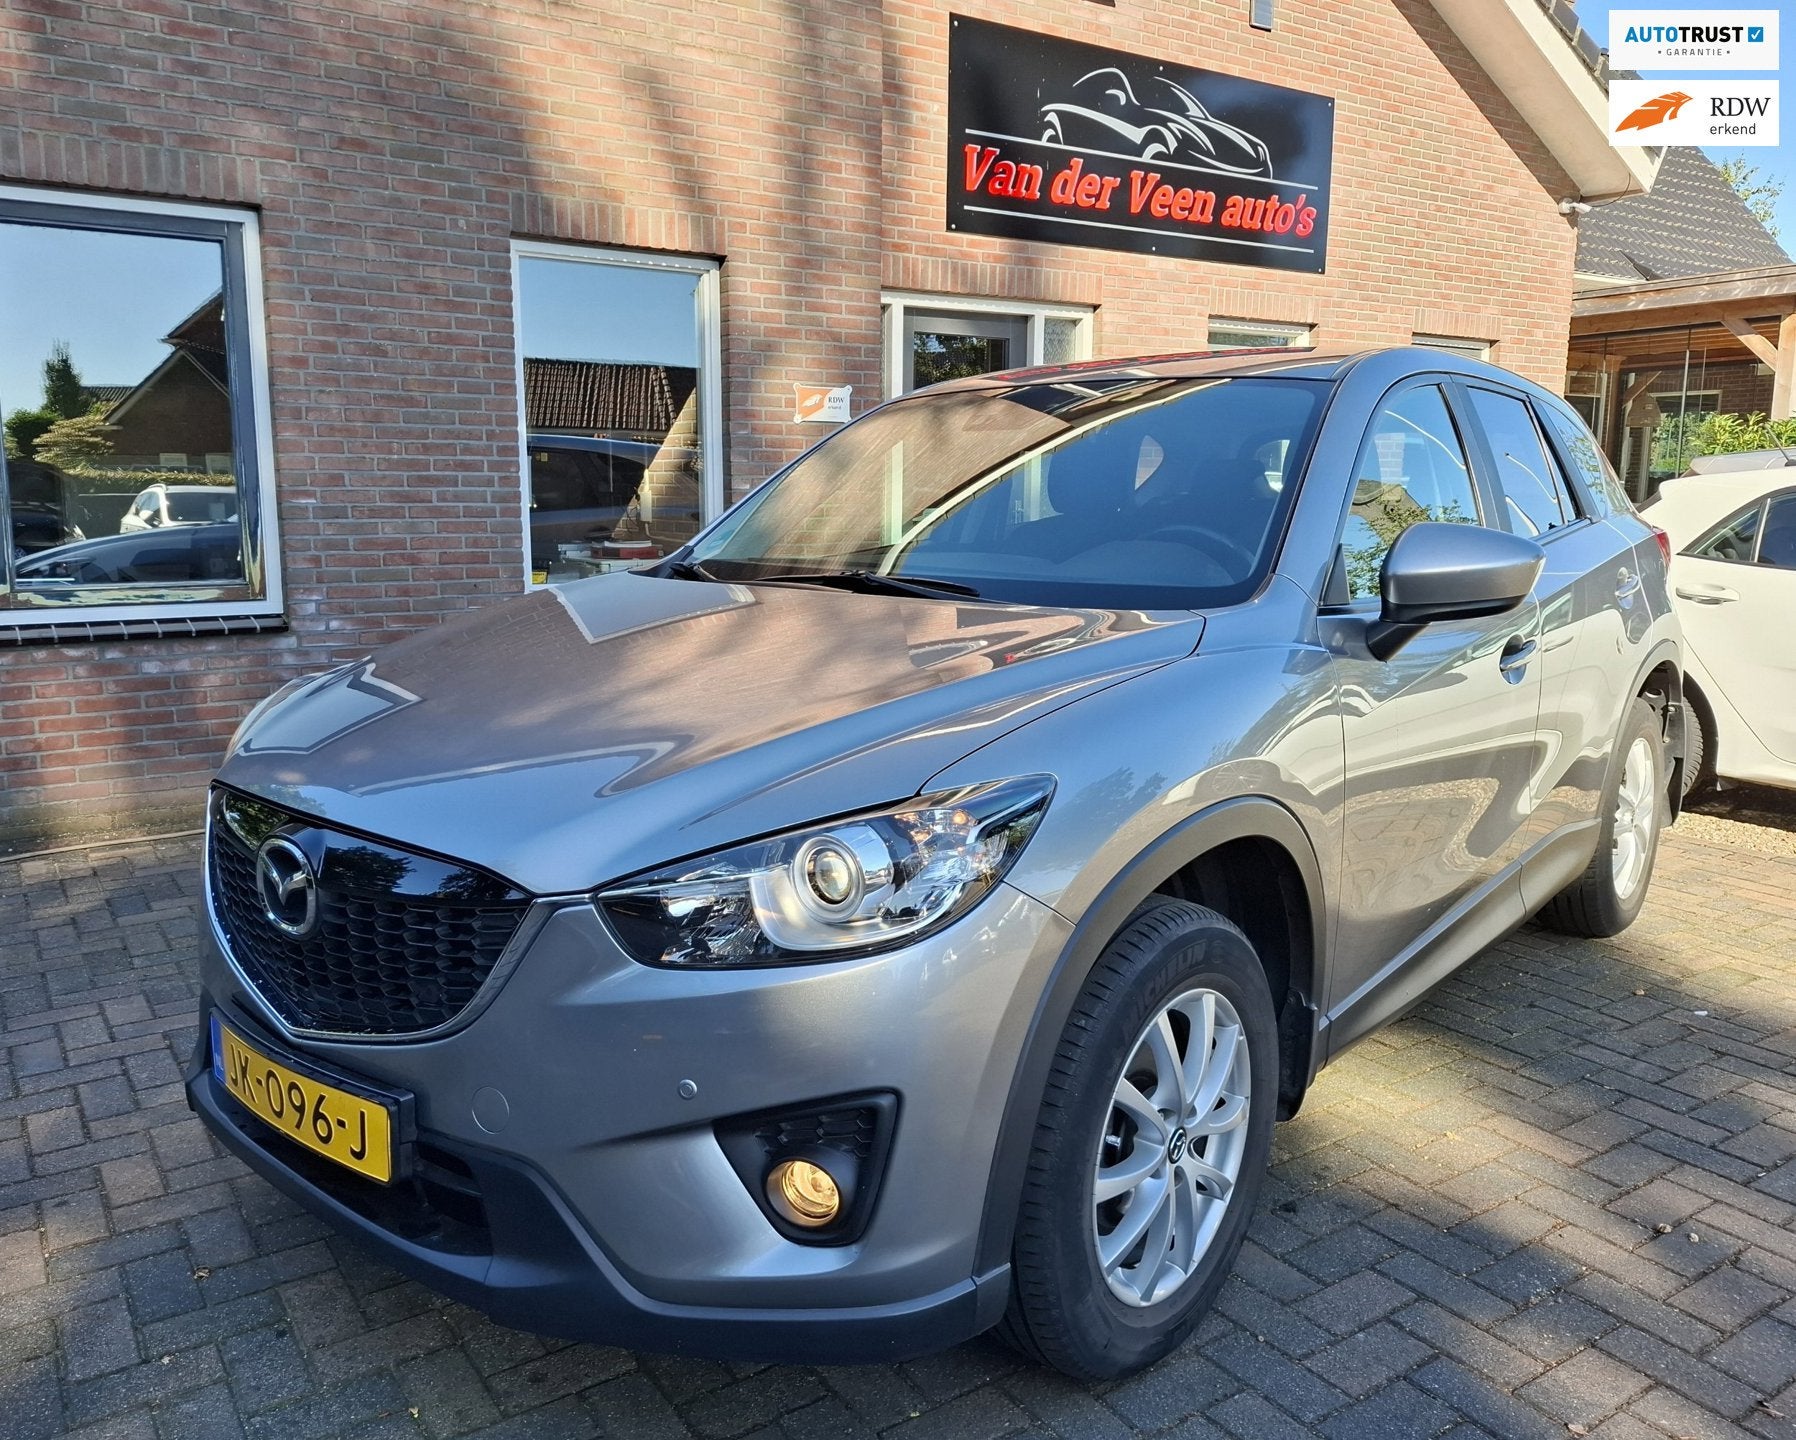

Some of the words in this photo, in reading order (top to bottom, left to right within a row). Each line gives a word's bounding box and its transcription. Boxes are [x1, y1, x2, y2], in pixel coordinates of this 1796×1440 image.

[964, 143, 1042, 201] Van
[1050, 157, 1120, 211] der
[1128, 169, 1214, 225] Veen
[1220, 193, 1317, 238] auto's
[828, 396, 845, 404] RDW
[229, 1042, 367, 1161] JK-096-J
